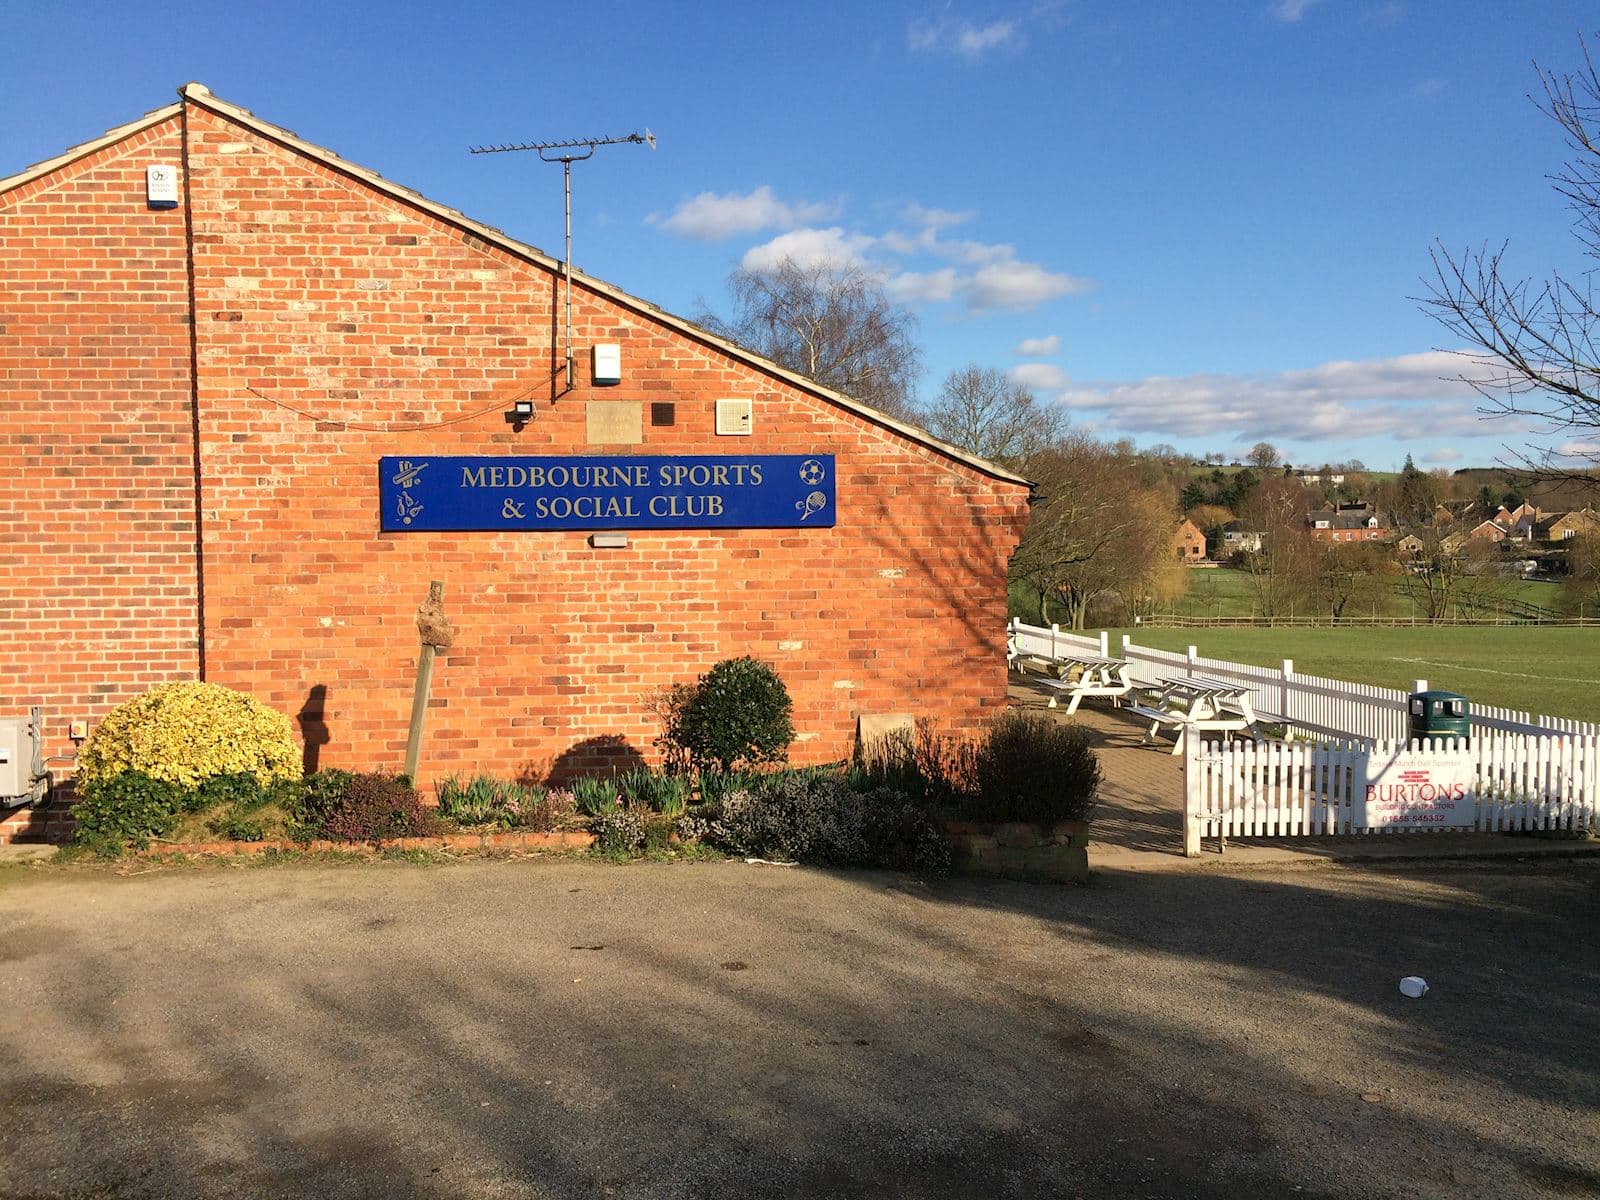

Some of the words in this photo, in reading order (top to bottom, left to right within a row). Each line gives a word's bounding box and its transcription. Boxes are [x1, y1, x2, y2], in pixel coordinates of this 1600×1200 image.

[460, 464, 650, 489] MEDBOURNE
[660, 463, 763, 487] SPORTS
[501, 497, 526, 519] &
[535, 495, 643, 519] SOCIAL
[649, 494, 724, 517] CLUB
[1365, 783, 1465, 802] BURTONS
[1406, 803, 1455, 811] CONTRACTORS
